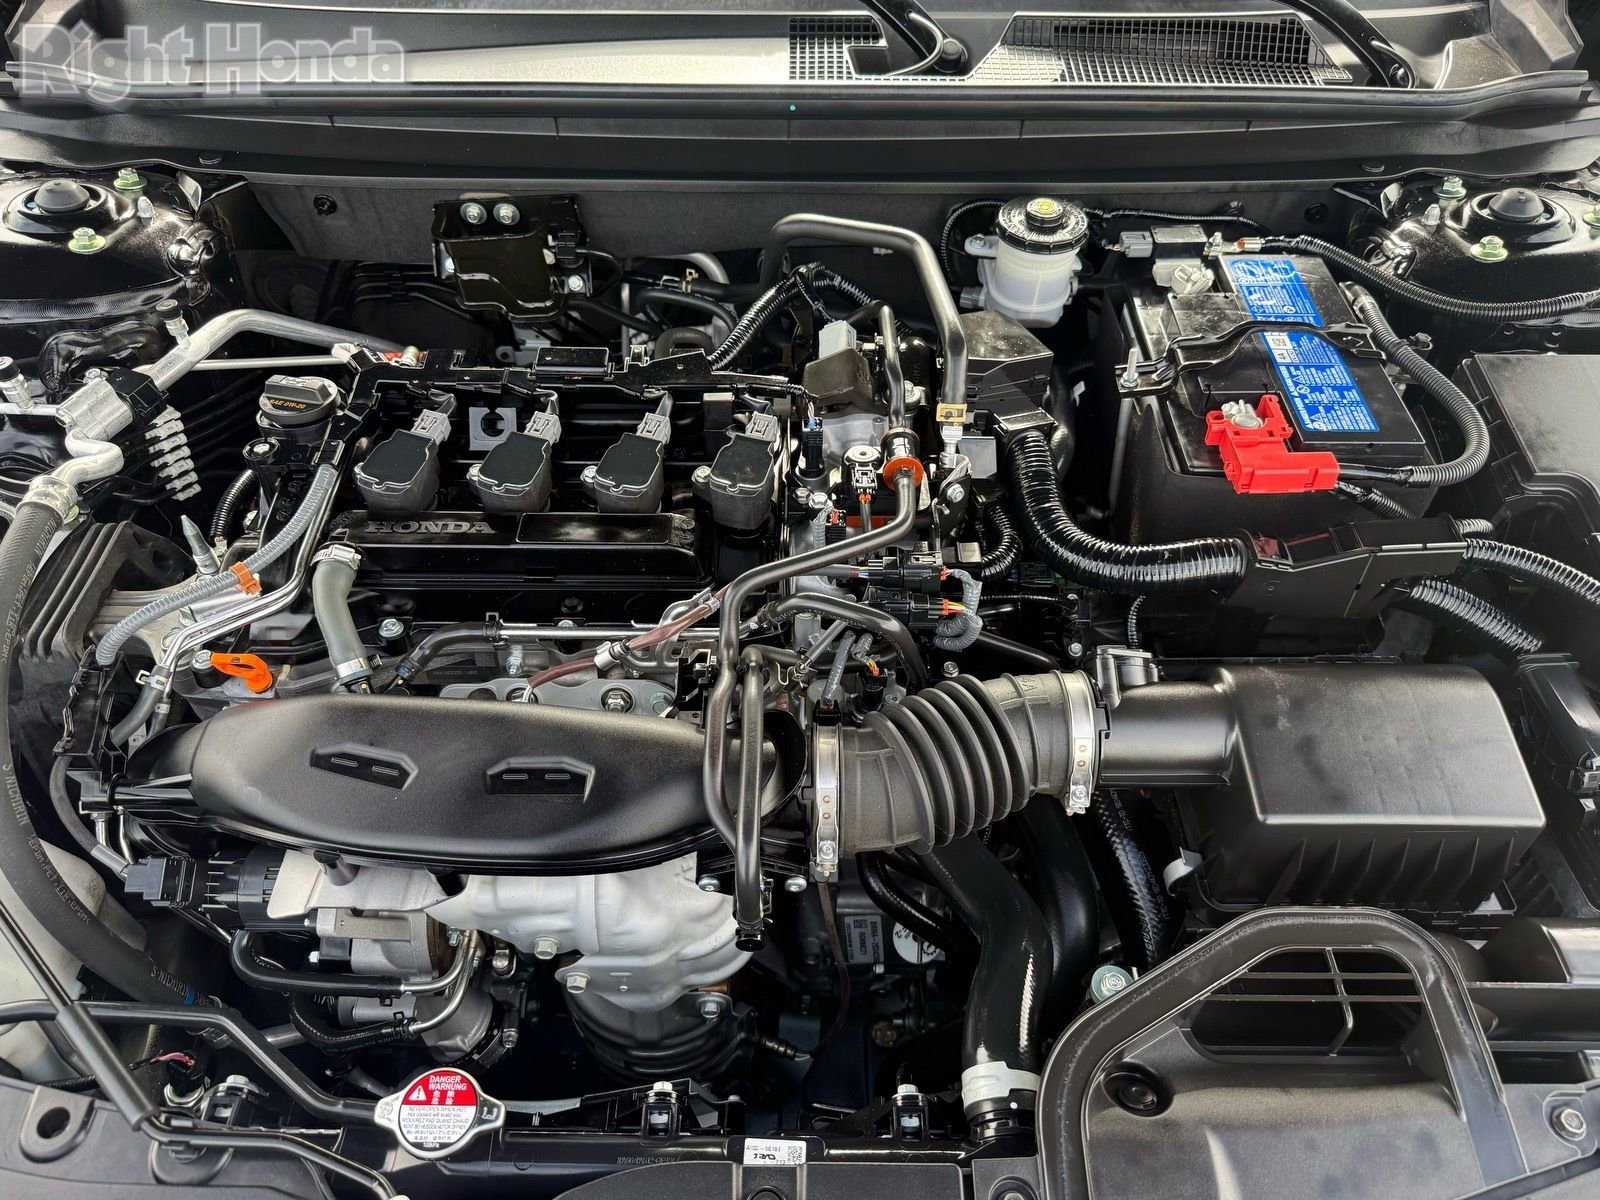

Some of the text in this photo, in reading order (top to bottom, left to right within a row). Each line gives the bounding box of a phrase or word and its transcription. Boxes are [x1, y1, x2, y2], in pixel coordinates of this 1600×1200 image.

[284, 401, 306, 409] 0W-20
[366, 520, 497, 534] HONDA
[428, 1082, 467, 1091] WARNUNG
